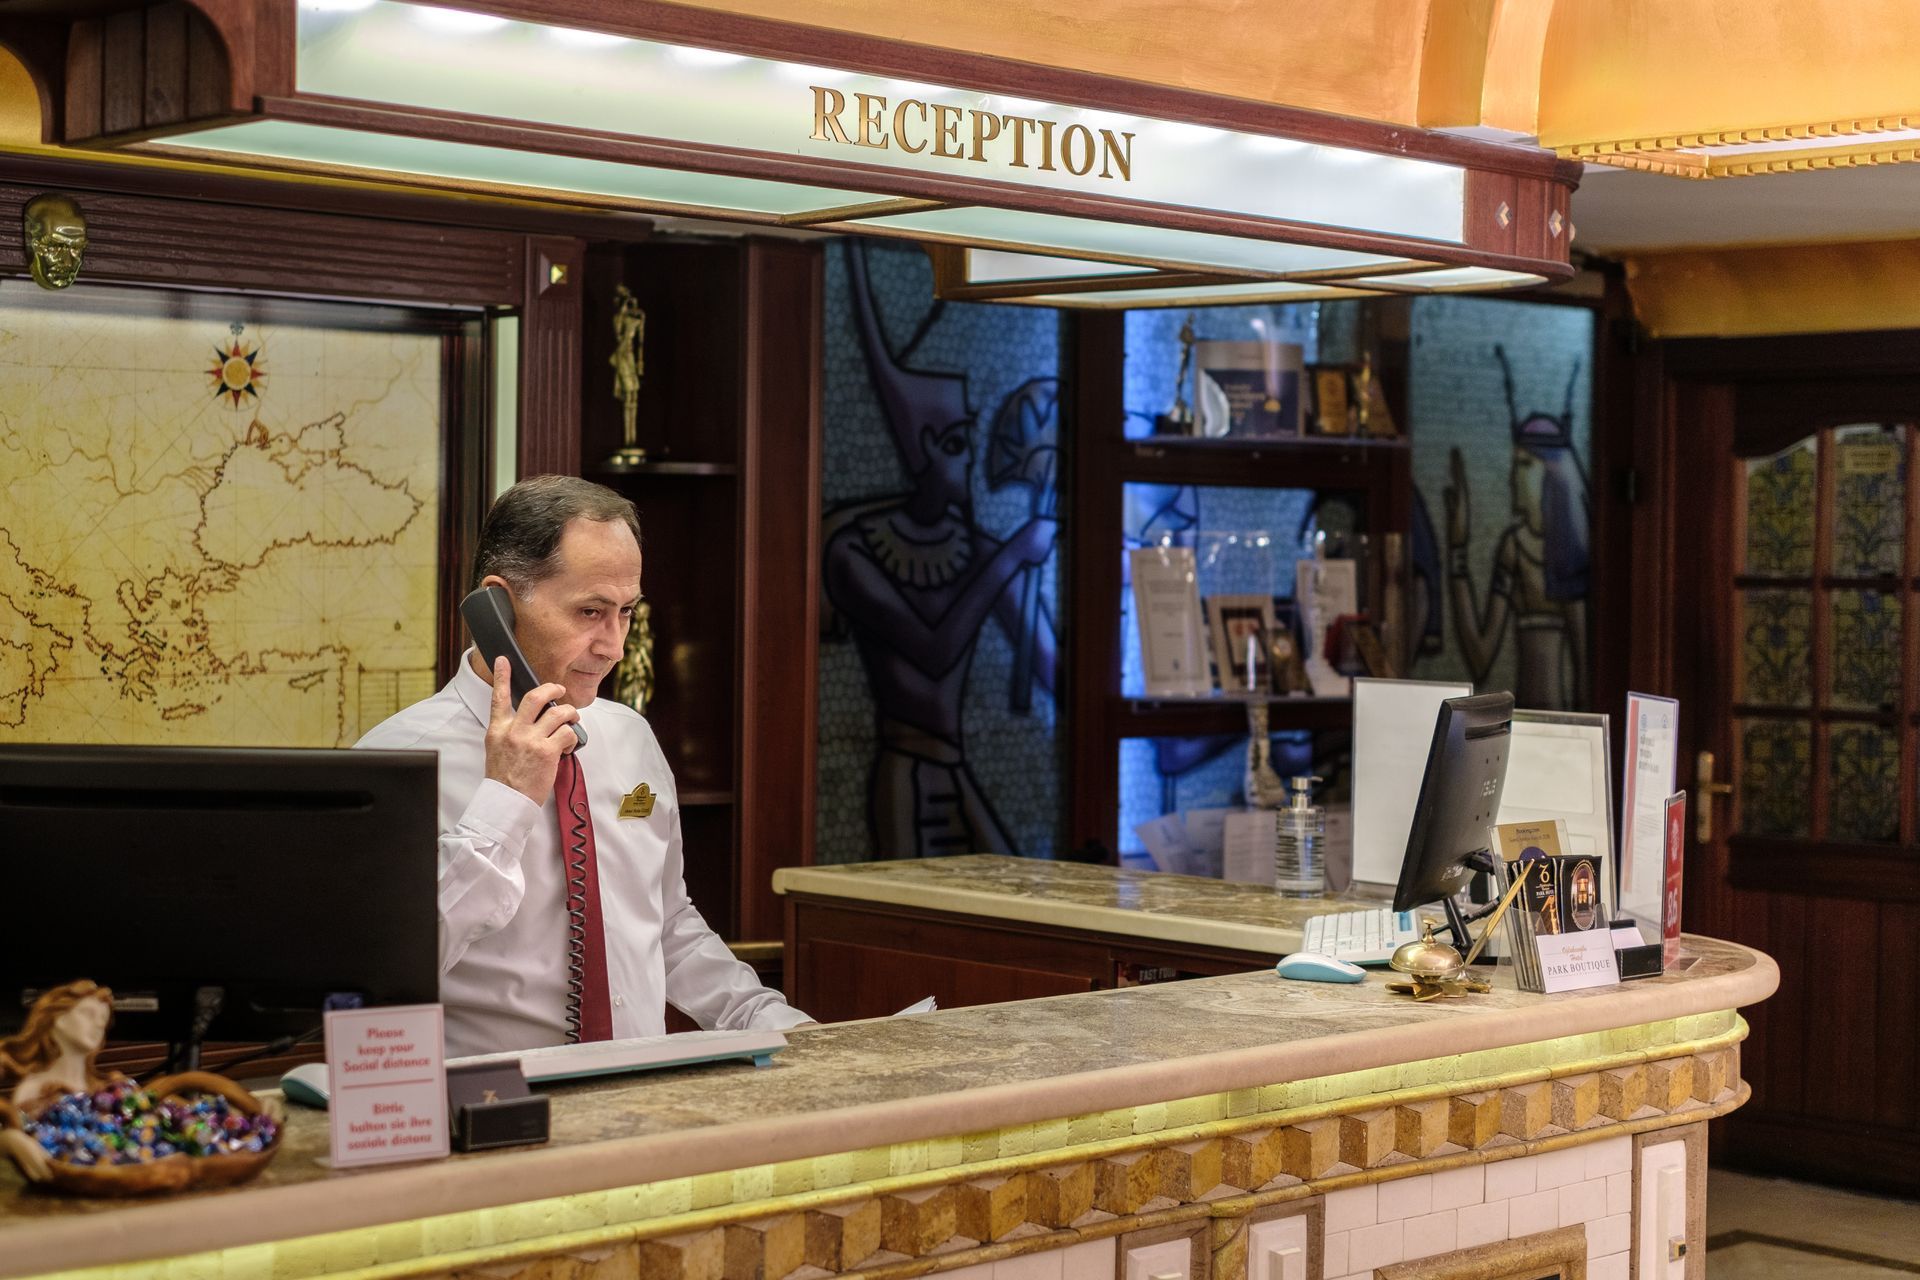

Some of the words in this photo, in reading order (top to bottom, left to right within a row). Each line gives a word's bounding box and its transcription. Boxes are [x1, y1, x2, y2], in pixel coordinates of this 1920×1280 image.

[809, 85, 1136, 181] RECEPTION
[1547, 964, 1569, 976] PARK
[1570, 959, 1611, 973] BOUTIQUE
[367, 1027, 405, 1039] Please
[357, 1045, 386, 1057] keep
[389, 1042, 415, 1055] your
[343, 1059, 379, 1073] Social
[383, 1057, 431, 1070] distance
